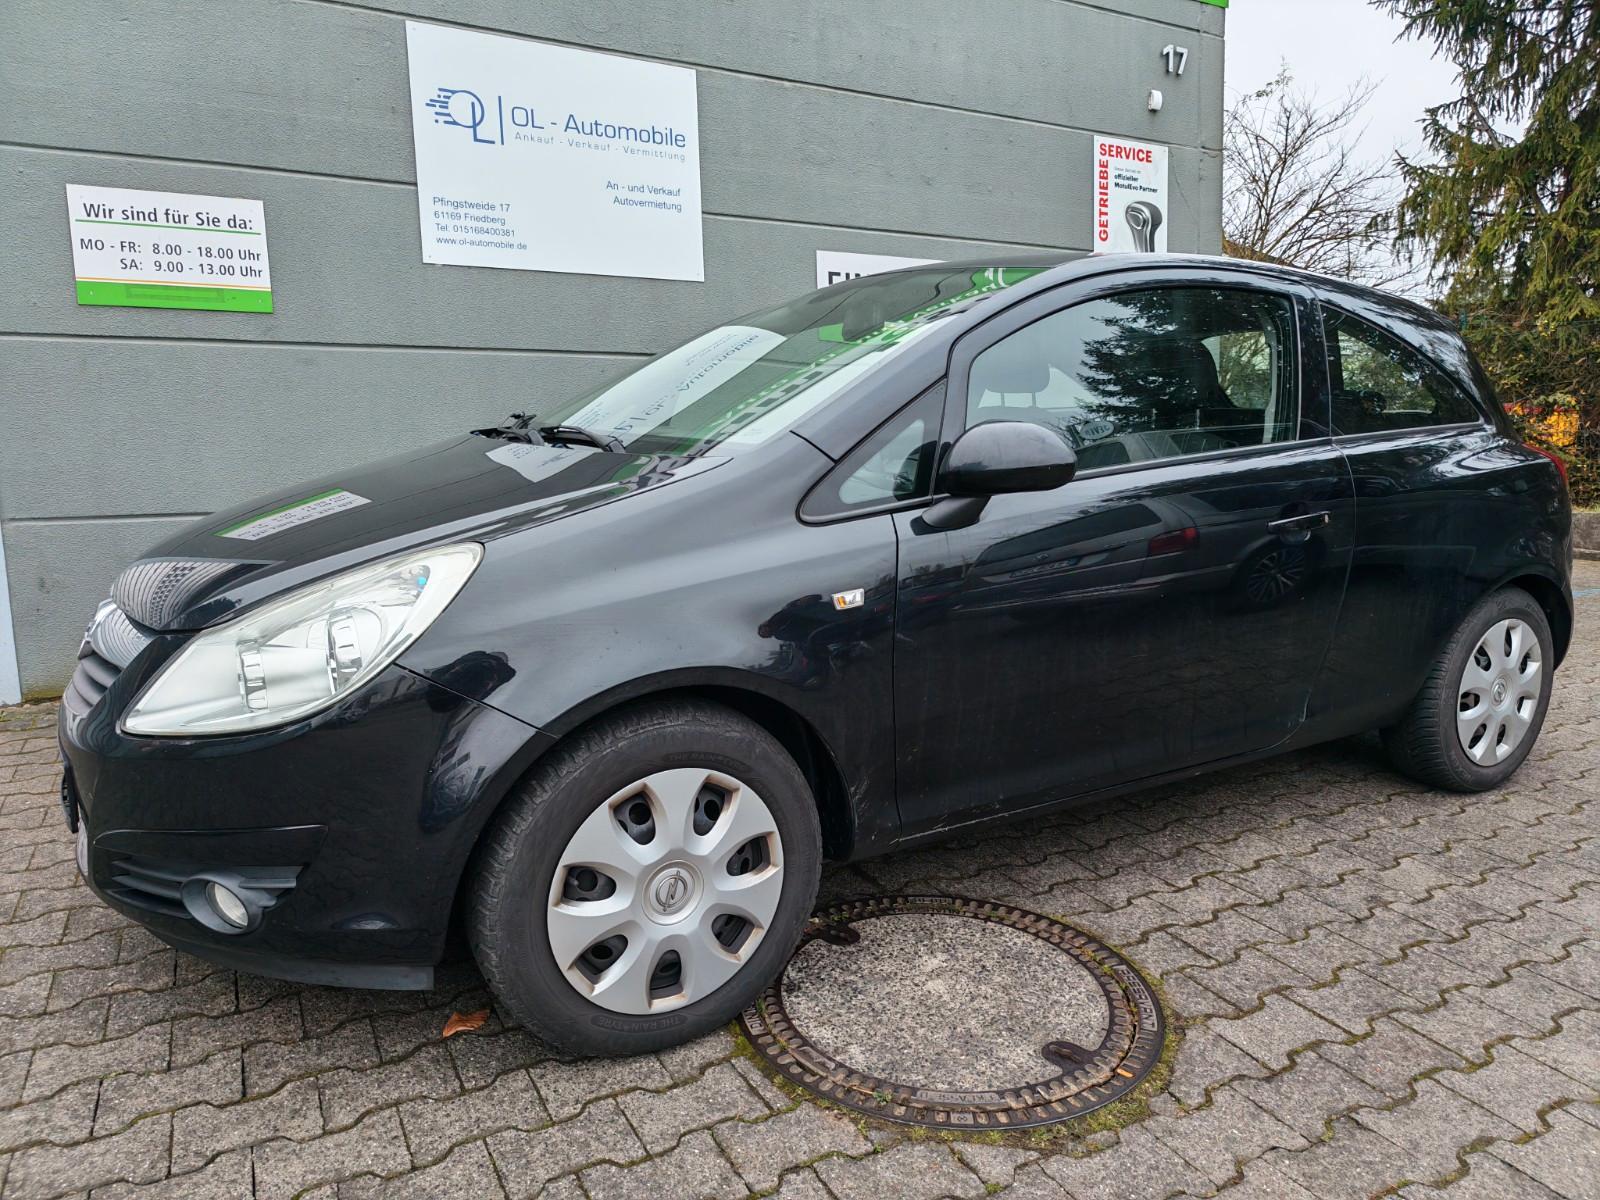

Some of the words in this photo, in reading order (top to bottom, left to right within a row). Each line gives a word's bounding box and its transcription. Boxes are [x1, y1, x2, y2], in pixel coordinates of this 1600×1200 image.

[1162, 44, 1188, 75] 17
[511, 106, 545, 129] OL
[563, 113, 686, 148] Automobile
[514, 131, 555, 145] Ankauf
[567, 138, 611, 151] Verkauf
[623, 145, 687, 163] Vermittlung
[1099, 143, 1153, 163] SERVICE
[606, 180, 619, 190] An
[627, 184, 645, 193] und
[646, 185, 681, 197] Verkauf
[1139, 185, 1158, 193] Partner
[432, 196, 497, 211] Pfingstweide
[499, 203, 511, 212] 17
[613, 195, 682, 213] Autovermietung
[1098, 159, 1109, 242] GETRIEBE
[83, 202, 115, 219] Wir
[121, 206, 158, 222] sind
[164, 208, 189, 225] für
[195, 212, 221, 228] Sie
[227, 214, 253, 230] da:
[434, 211, 461, 220] 61169
[464, 213, 506, 226] Friedberg
[453, 225, 515, 237] 015168400381
[80, 238, 105, 251] MO
[120, 240, 142, 254] FR:
[152, 243, 182, 256] 8.00
[197, 246, 234, 260] 18.00
[238, 249, 261, 262] Uhr
[436, 237, 528, 250] www.ol-automobile.de
[120, 258, 143, 271] SA:
[154, 260, 184, 273] 9.00
[198, 263, 235, 276] 13.00
[240, 265, 263, 278] Uhr
